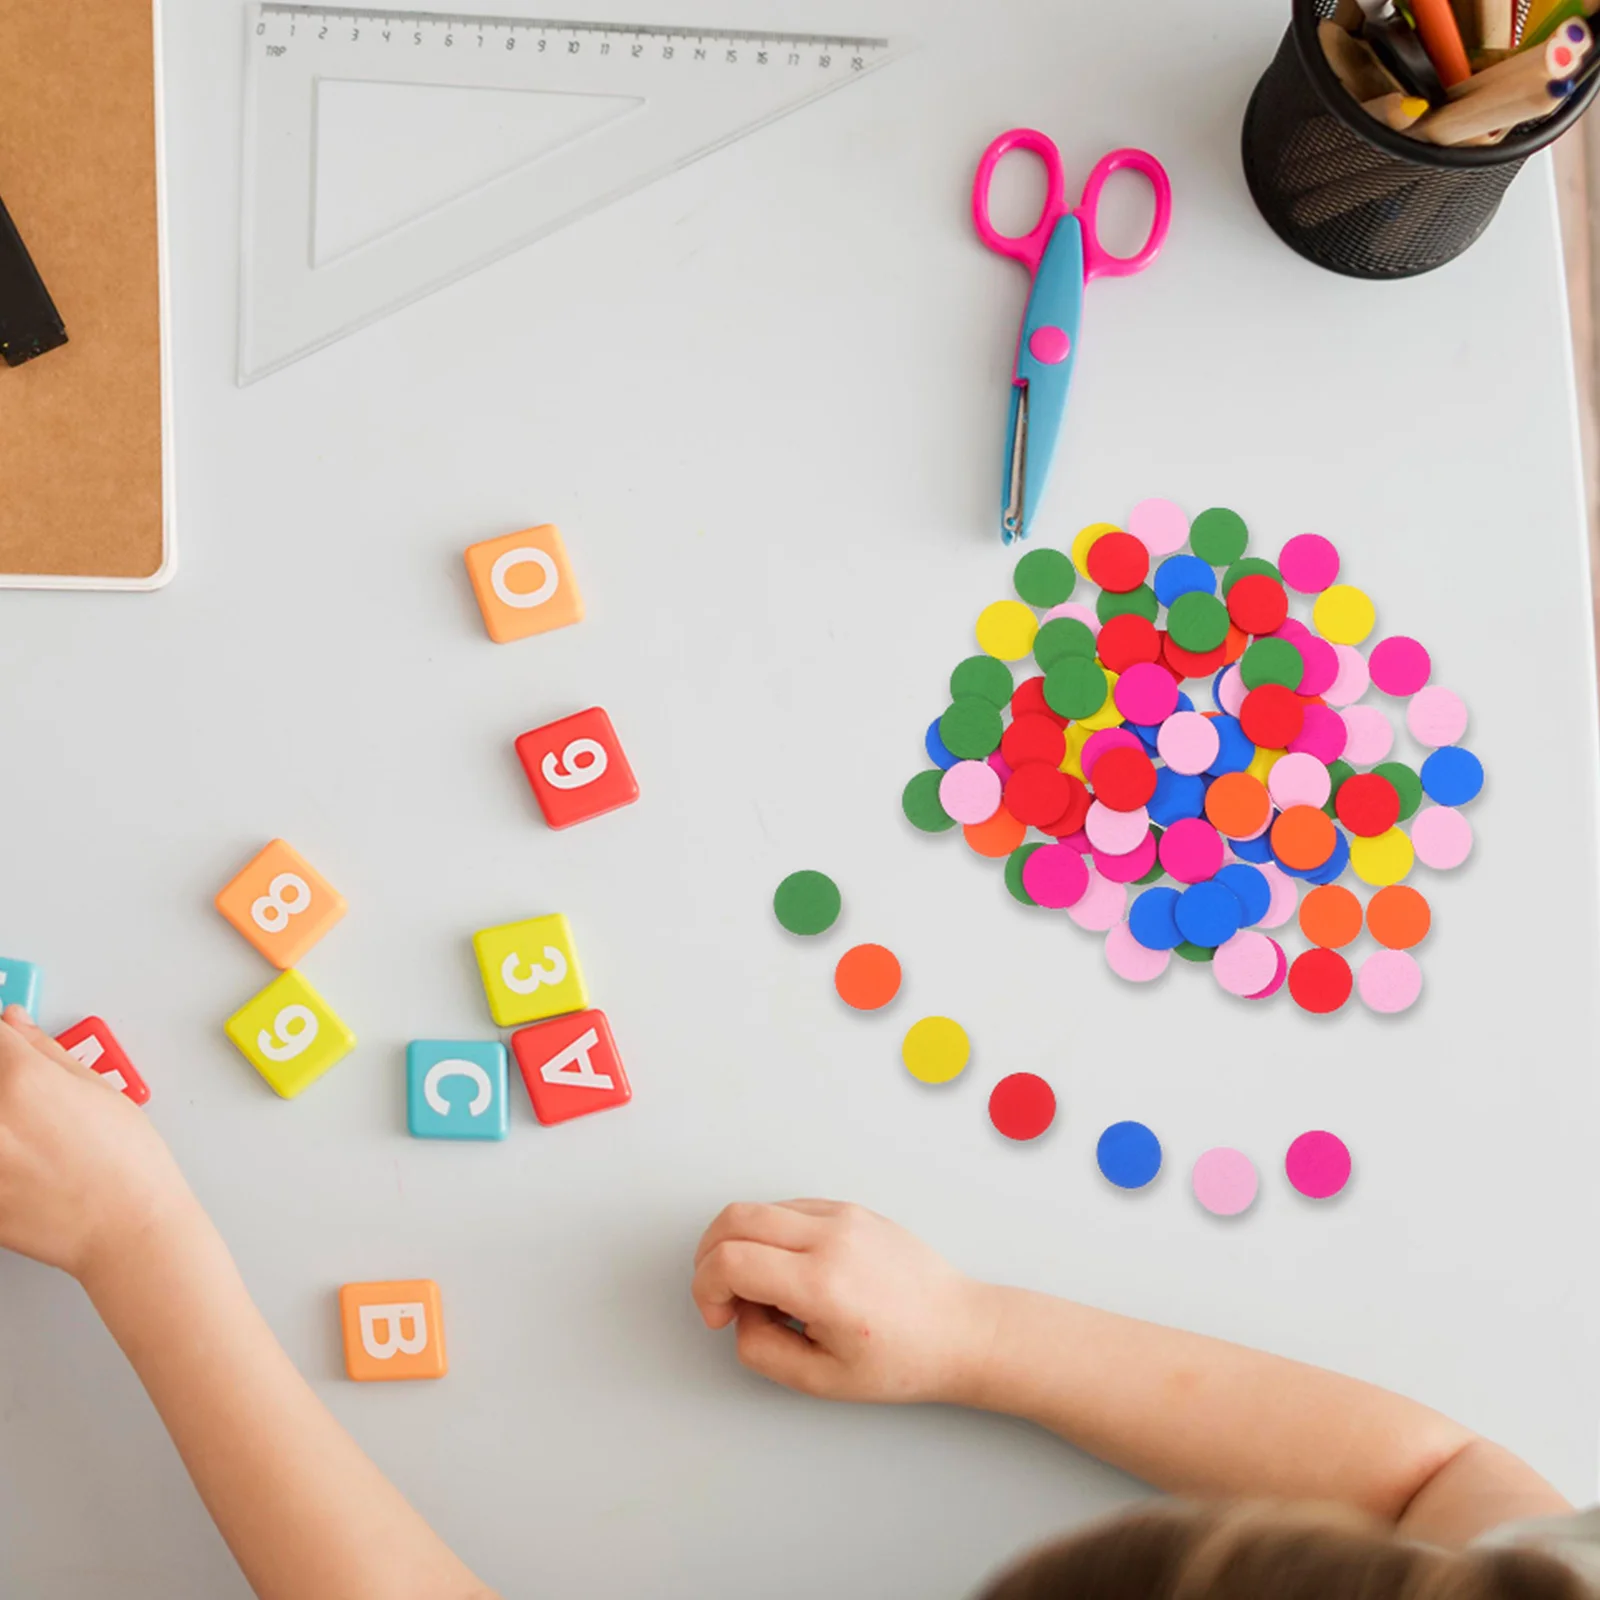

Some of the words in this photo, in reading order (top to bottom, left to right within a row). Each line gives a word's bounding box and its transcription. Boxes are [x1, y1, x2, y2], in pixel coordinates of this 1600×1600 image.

[256, 22, 266, 36] 0
[290, 24, 296, 37] 1
[318, 26, 328, 40] 2
[351, 28, 360, 41] 3
[382, 30, 391, 42] 4
[413, 32, 422, 45] 5
[444, 34, 453, 47] 6
[477, 35, 484, 47] 7
[505, 37, 515, 51] 8
[537, 39, 546, 52] 9
[568, 41, 580, 54] 10
[600, 43, 610, 55] 11
[631, 45, 643, 58] 12
[662, 46, 674, 59] 13
[694, 49, 706, 60] 14
[726, 50, 737, 63] 15
[757, 51, 768, 65] 16
[788, 53, 800, 66] 17
[819, 55, 831, 68] 18
[851, 57, 863, 71] 19
[251, 873, 311, 932] 8
[501, 946, 567, 994] 3
[423, 1058, 493, 1117] C
[541, 1027, 615, 1090] A
[359, 1302, 427, 1360] B
